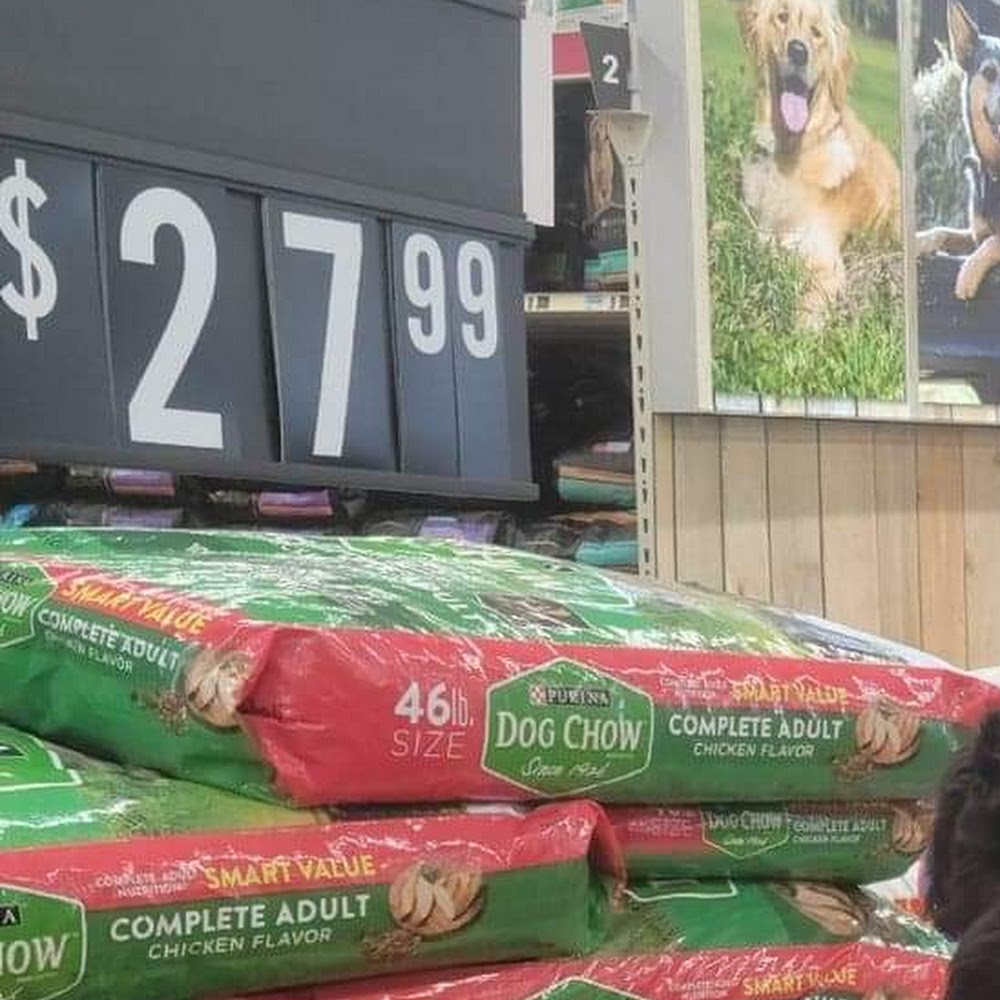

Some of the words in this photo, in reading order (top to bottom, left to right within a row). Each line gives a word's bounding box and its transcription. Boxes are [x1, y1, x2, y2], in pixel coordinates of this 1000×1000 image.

[601, 54, 619, 84] 2
[62, 581, 140, 614] SMART
[138, 599, 213, 634] VALUE
[38, 608, 117, 648] COMPLETE
[122, 635, 180, 671] ADULT
[732, 682, 789, 703] SMART
[791, 683, 848, 704] VALUE
[495, 711, 556, 749] DOG
[564, 714, 643, 751] CHOW
[669, 715, 772, 737] COMPLETE
[777, 718, 843, 740] ADULT
[391, 730, 467, 759] SIZE
[693, 743, 756, 757] CHICKEN
[761, 744, 814, 758] FLAVOR
[204, 859, 294, 889] SMART
[301, 854, 376, 881] VALUE
[111, 906, 265, 942] COMPLETE
[275, 894, 371, 925] ADULT
[149, 938, 244, 960] CHICKEN
[251, 928, 332, 949] FLAVOR
[743, 974, 801, 996] SMART
